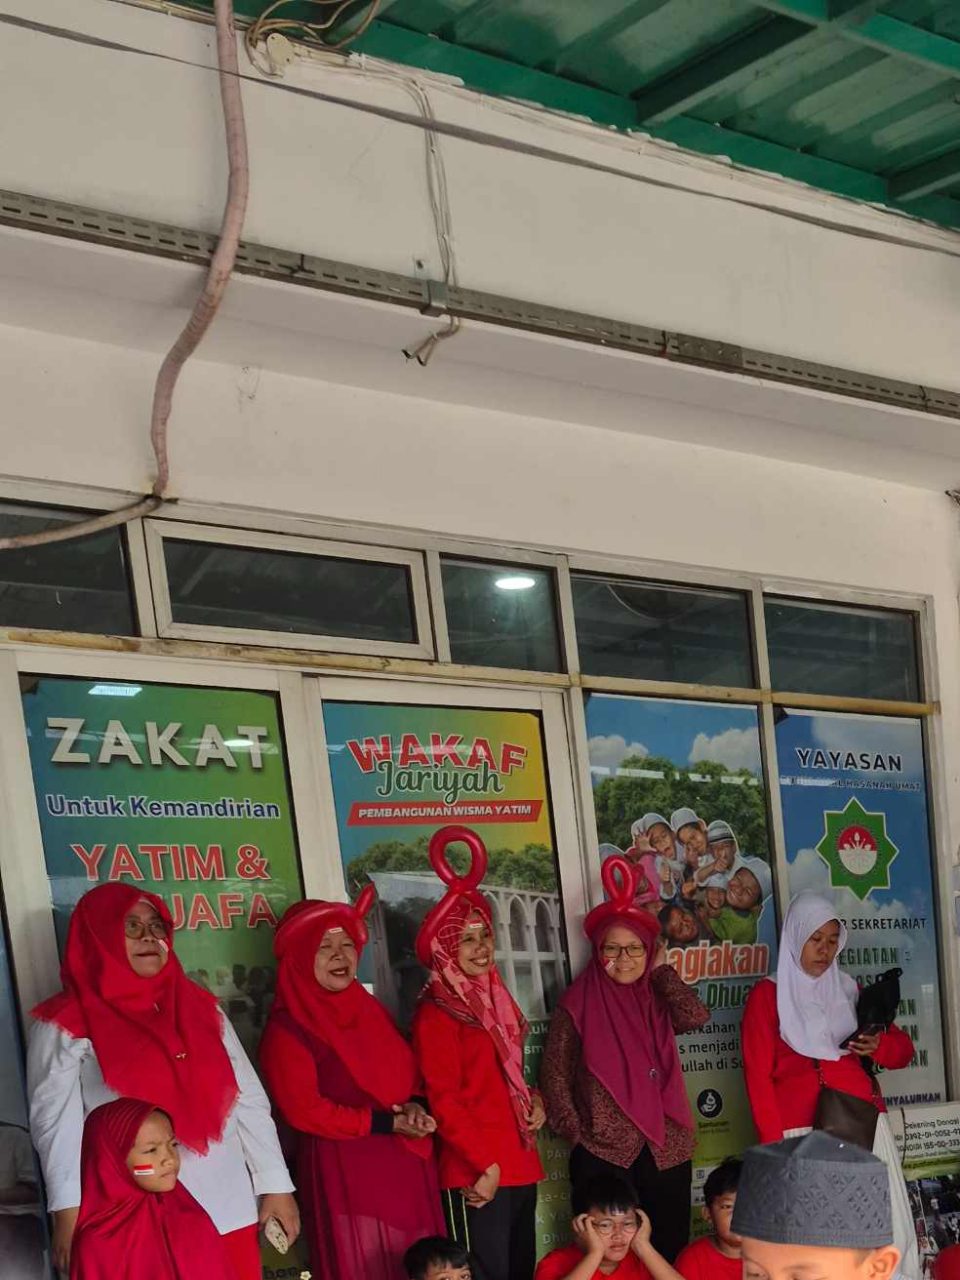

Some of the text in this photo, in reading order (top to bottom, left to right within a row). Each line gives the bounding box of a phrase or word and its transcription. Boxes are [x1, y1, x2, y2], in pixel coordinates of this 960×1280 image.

[47, 717, 268, 769] ZAKAT
[346, 732, 528, 775] WAKAF
[796, 747, 902, 773] YAYASAN
[376, 759, 504, 806] Jariyah
[46, 795, 280, 819] Untuk Kemandirian
[358, 805, 532, 819] PEMBANGUNAN WISMA YATIM
[70, 844, 271, 881] YATIM &
[852, 917, 928, 930] SEKRETARIAT
[668, 940, 769, 985] agiakan
[837, 948, 899, 966] EGIATAN
[689, 1040, 740, 1055] menjadi
[682, 1060, 713, 1073] ullah
[716, 1059, 729, 1071] di
